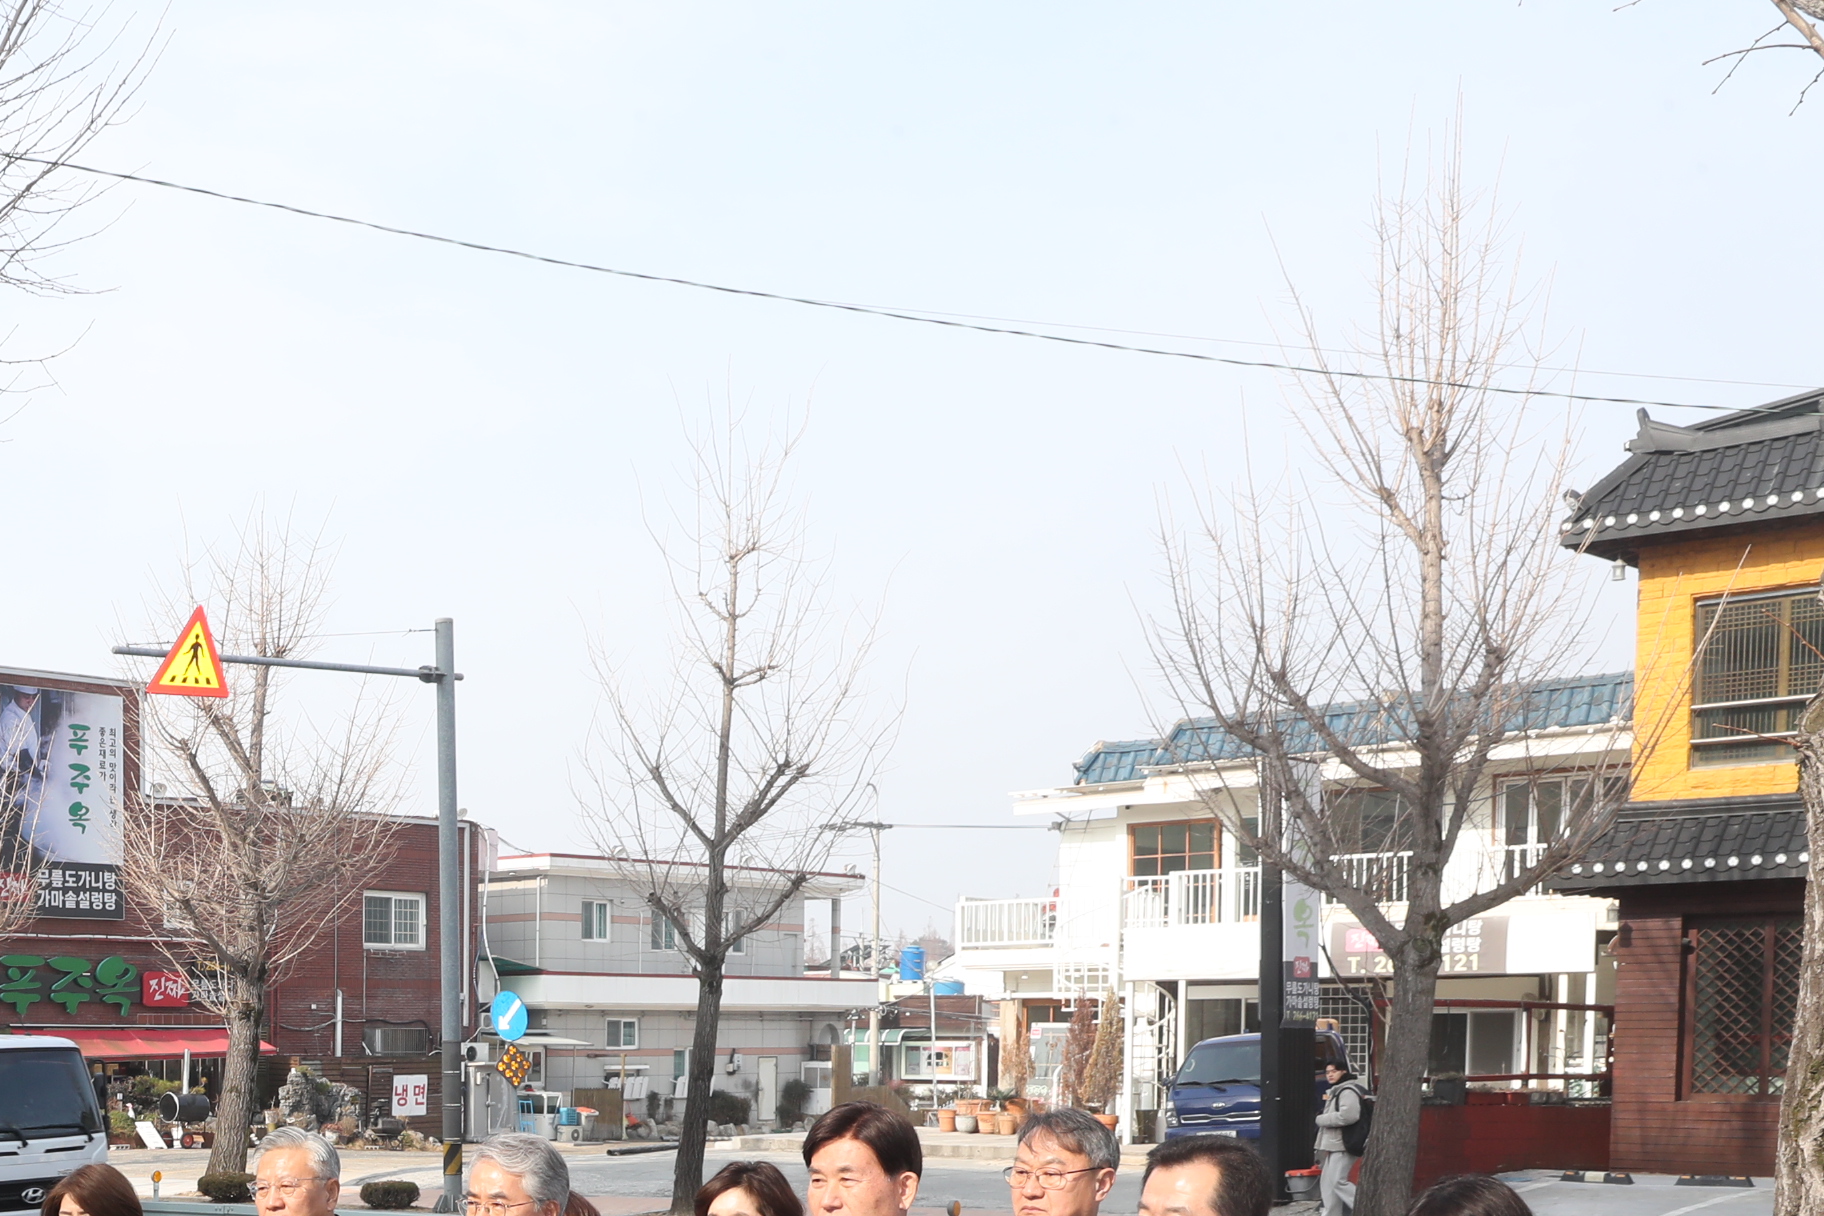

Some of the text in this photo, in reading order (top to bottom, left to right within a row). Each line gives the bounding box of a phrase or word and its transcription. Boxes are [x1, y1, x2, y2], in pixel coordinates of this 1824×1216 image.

[98, 727, 107, 782] 좋은재료가
[38, 870, 117, 891] 무릎도가니탕
[38, 889, 117, 911] 가마솥설렁탕
[1347, 956, 1366, 974] T.
[394, 1083, 426, 1107] 냉면
